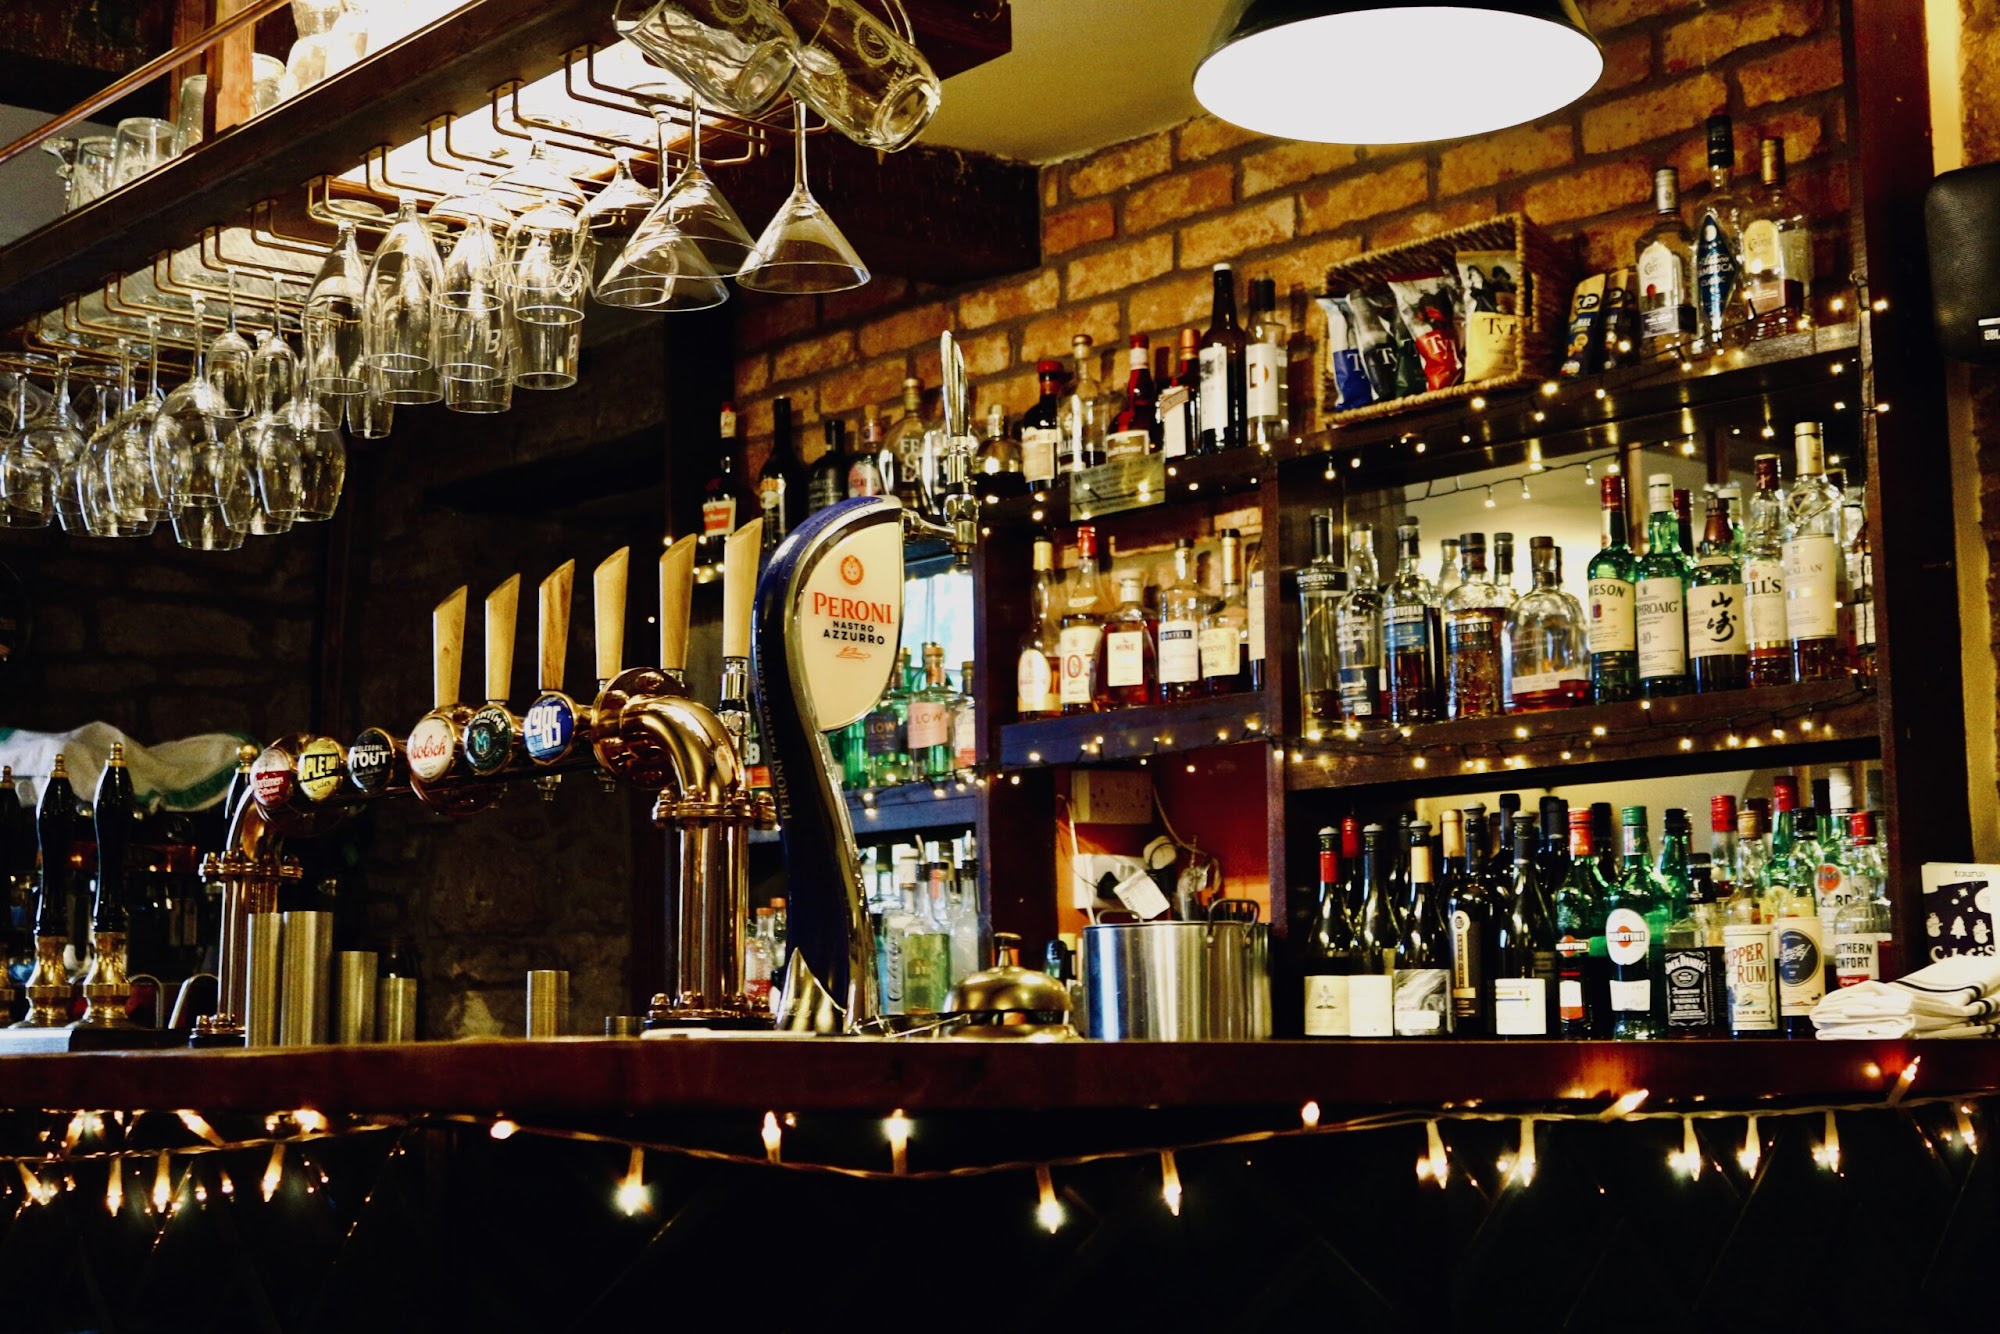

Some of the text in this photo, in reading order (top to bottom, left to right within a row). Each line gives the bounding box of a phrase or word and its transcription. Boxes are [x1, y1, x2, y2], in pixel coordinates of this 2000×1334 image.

[813, 591, 892, 625] PERONI
[833, 620, 874, 632] NASTRO
[823, 628, 885, 645] AZZURRO
[525, 705, 562, 749] 1985
[1737, 964, 1767, 983] RUM
